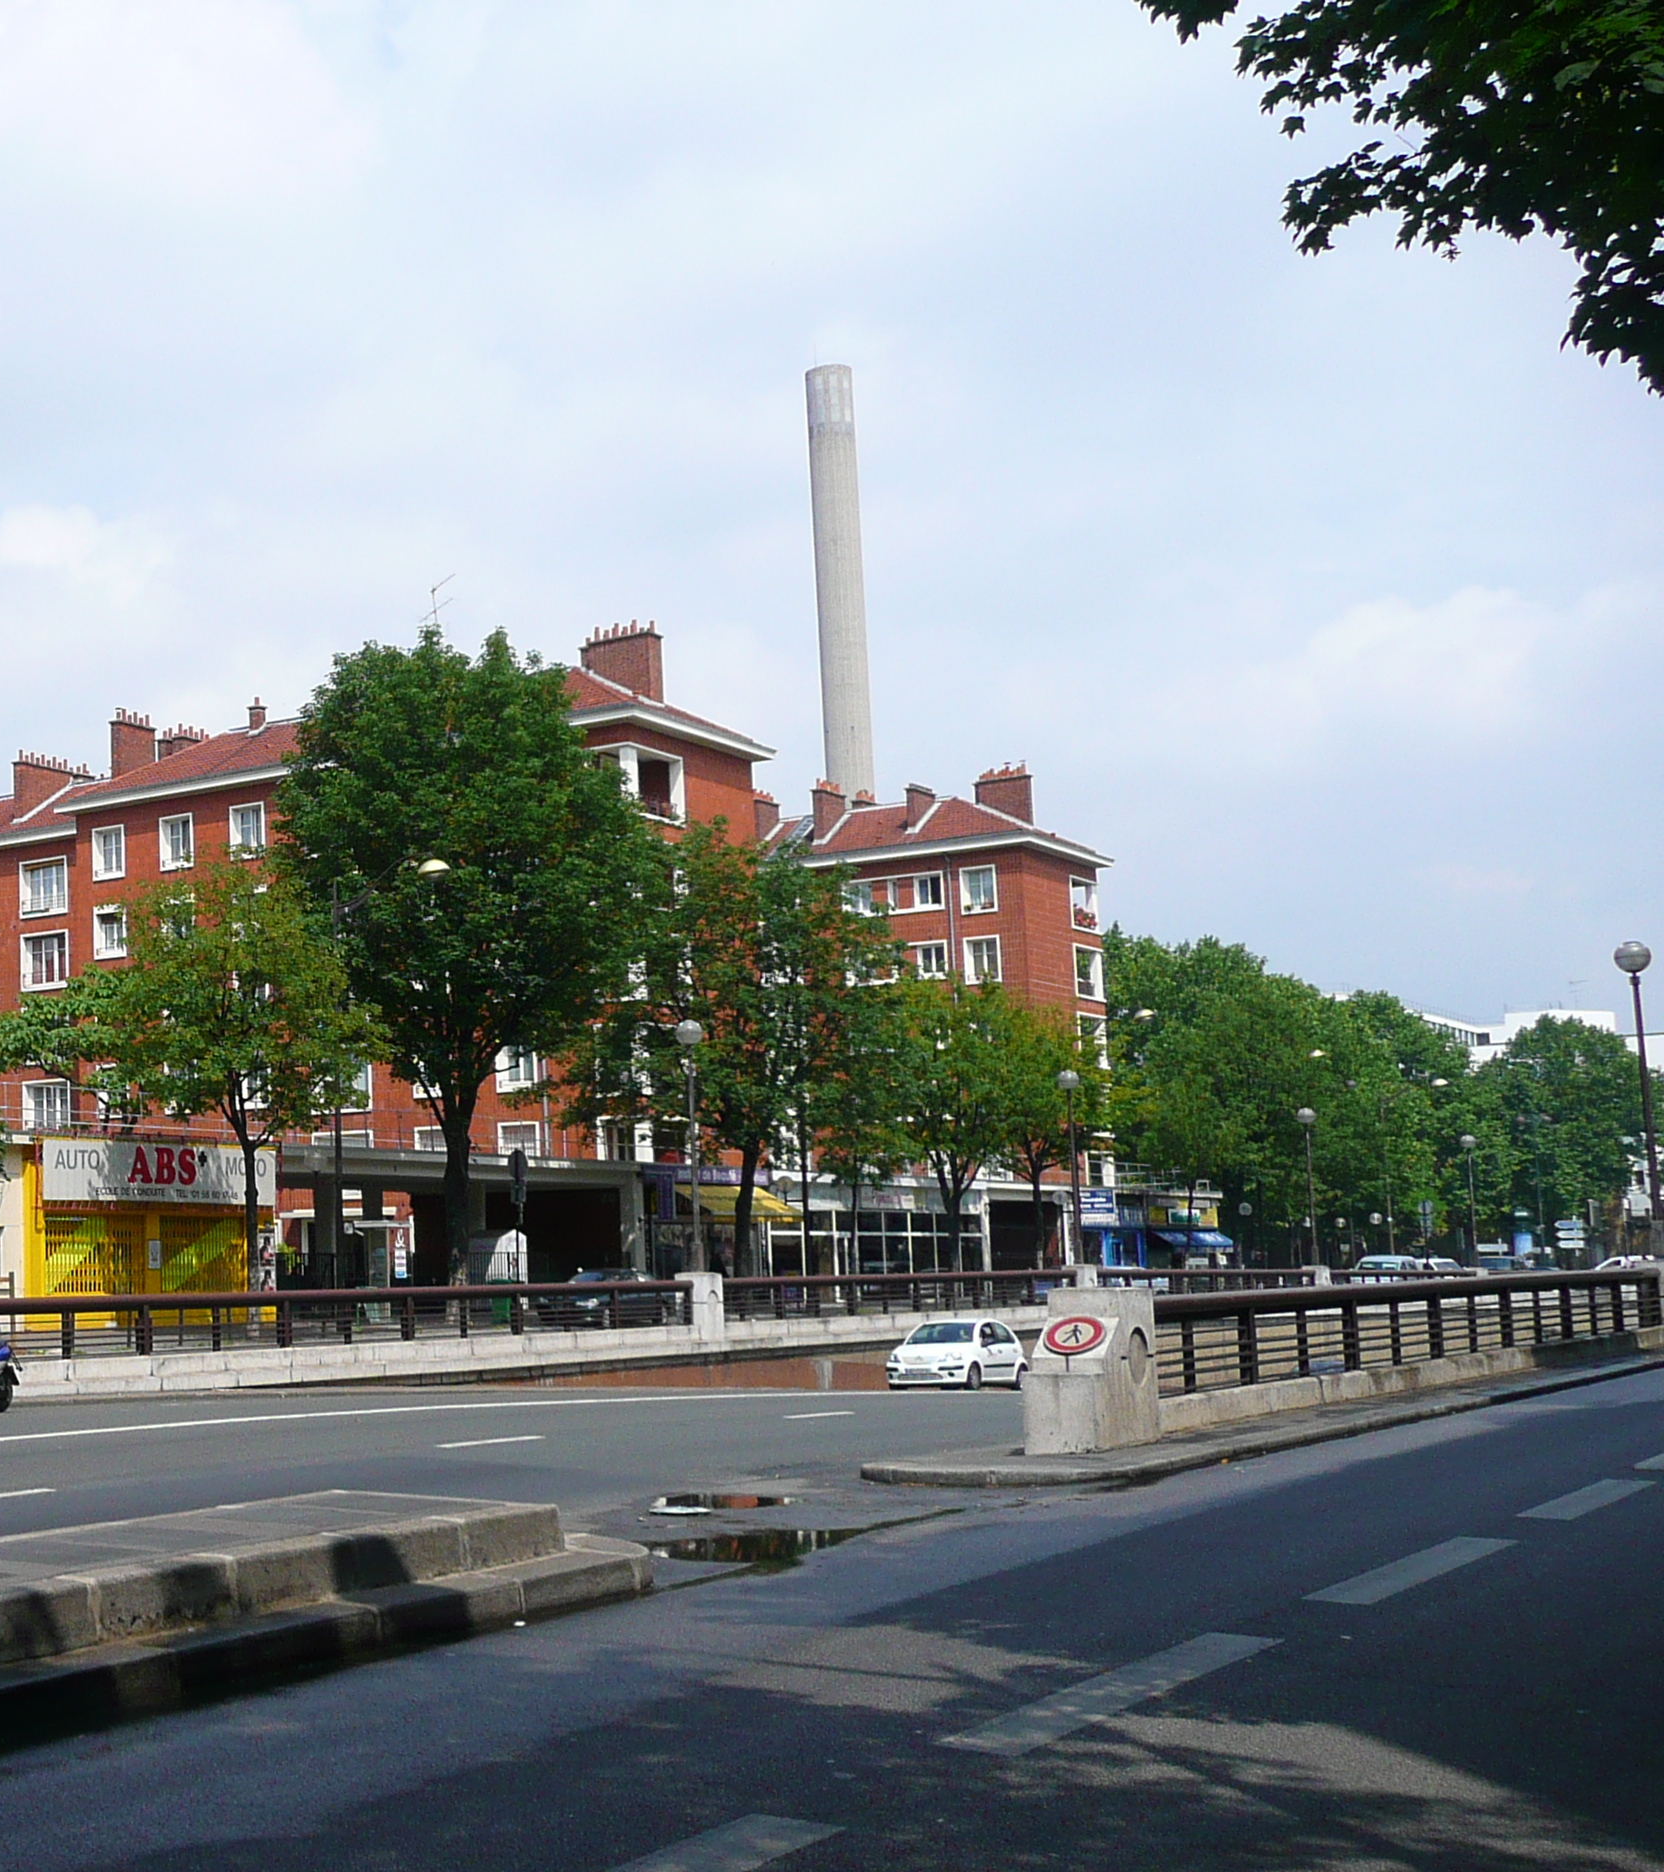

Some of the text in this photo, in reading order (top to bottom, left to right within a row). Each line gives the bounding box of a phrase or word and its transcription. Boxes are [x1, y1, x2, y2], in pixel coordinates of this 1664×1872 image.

[55, 1149, 100, 1170] AUTO
[225, 1156, 267, 1178] MOO
[95, 1187, 118, 1196] ECOLE
[120, 1187, 130, 1196] DE
[132, 1188, 165, 1197] CONDUITE
